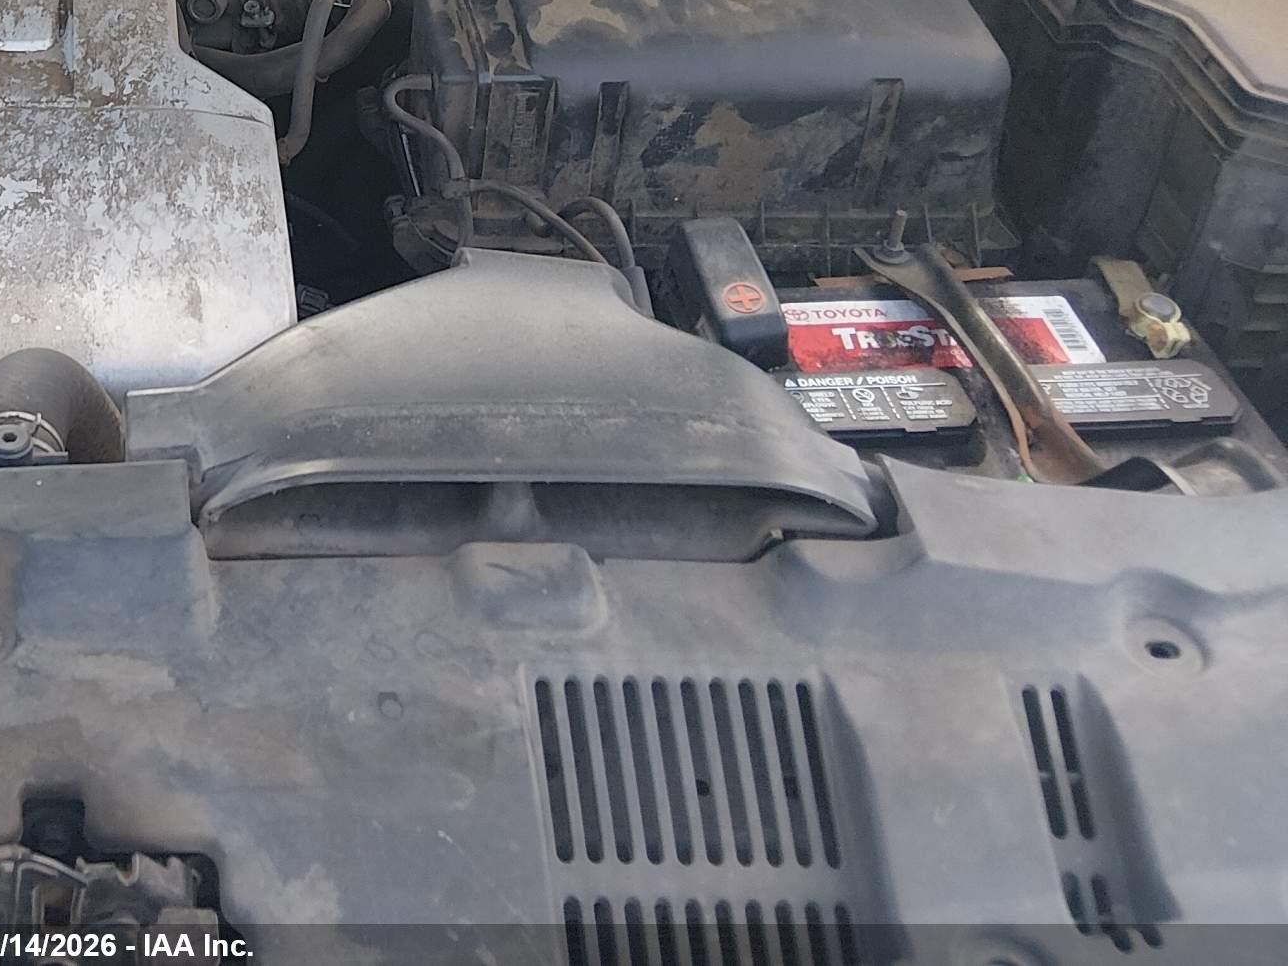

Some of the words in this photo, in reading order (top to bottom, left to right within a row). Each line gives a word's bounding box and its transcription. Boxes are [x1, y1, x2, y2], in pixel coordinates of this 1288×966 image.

[812, 307, 888, 320] TOYOTA
[797, 377, 854, 387] DANGER
[867, 375, 918, 385] POISON
